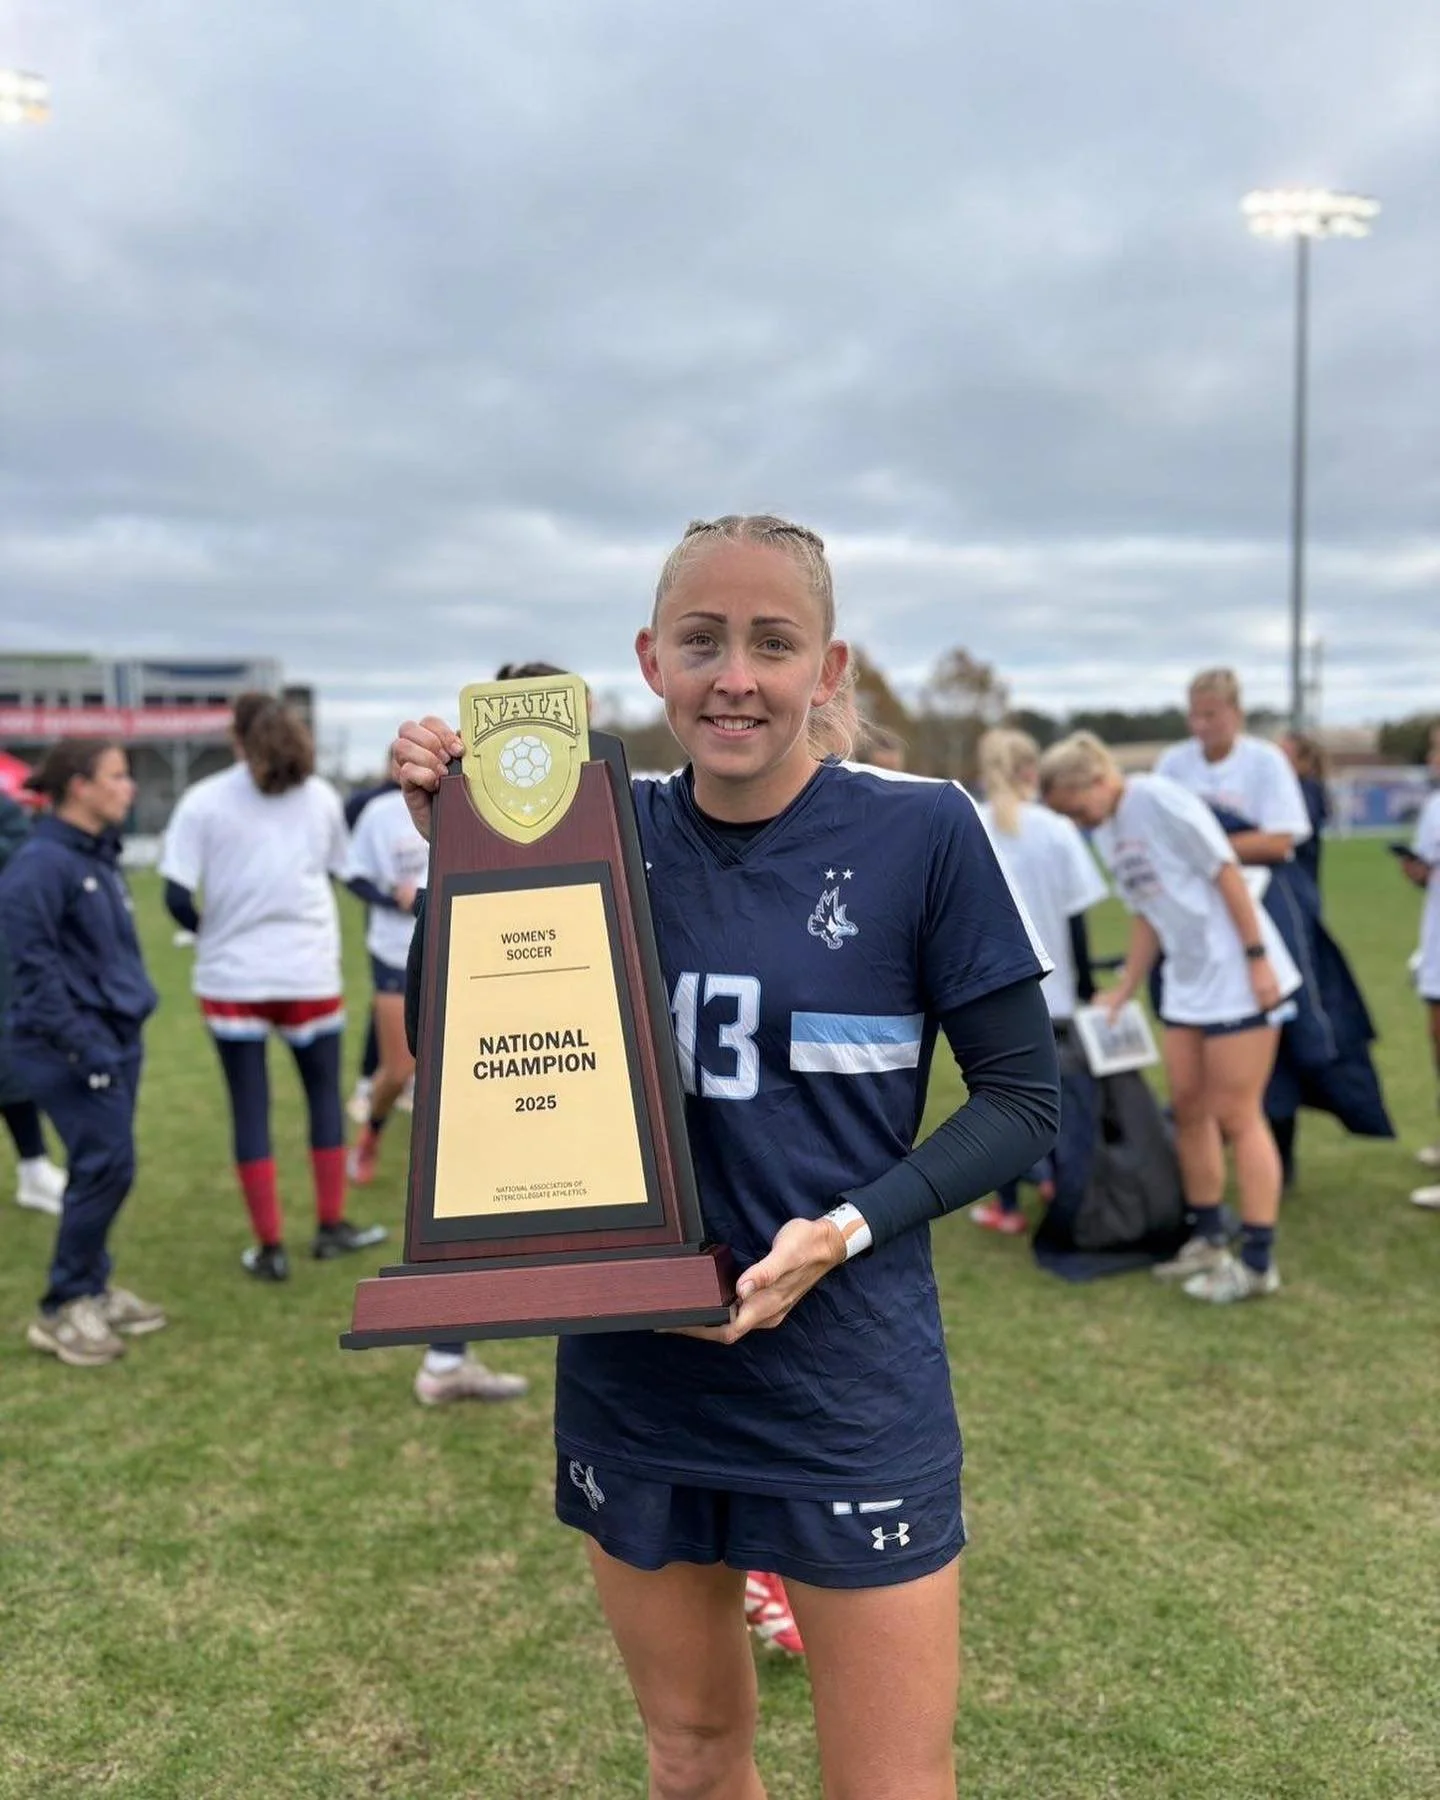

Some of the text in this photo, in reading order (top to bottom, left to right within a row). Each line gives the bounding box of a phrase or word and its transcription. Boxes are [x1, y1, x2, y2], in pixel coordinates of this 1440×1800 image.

[473, 690, 573, 739] NAIA
[501, 929, 556, 944] WOMEN'S
[506, 946, 552, 960] SOCCER
[479, 1029, 589, 1055] NATIONAL
[670, 971, 762, 1100] 13
[473, 1052, 596, 1080] CHAMPION
[515, 1095, 557, 1112] 2025
[493, 1188, 587, 1202] INTERCOLLEGIATE ATHLETICS
[495, 1185, 527, 1193] NATIONAL
[530, 1181, 573, 1190] ASSOCIATION
